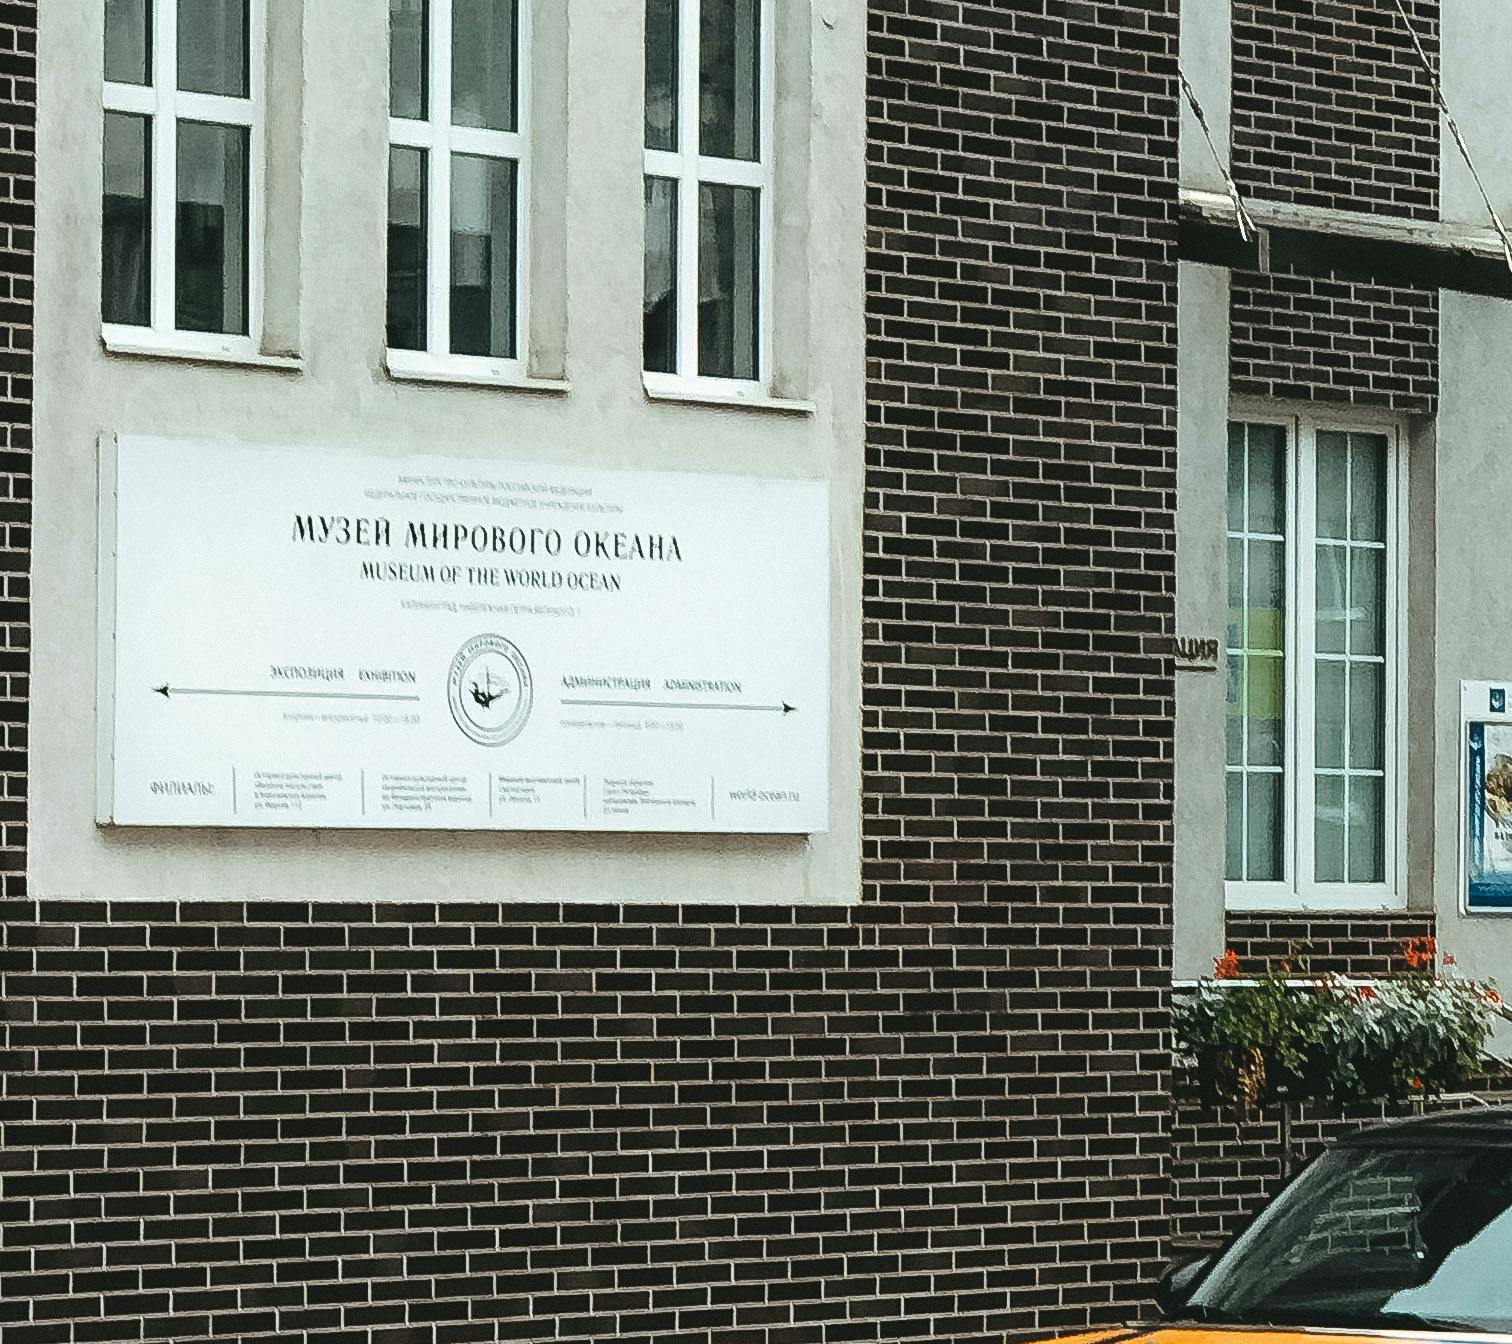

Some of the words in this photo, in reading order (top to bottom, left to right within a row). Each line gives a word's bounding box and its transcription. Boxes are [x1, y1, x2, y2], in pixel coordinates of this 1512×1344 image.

[291, 513, 391, 547] МУЗЕЙ
[404, 521, 561, 556] МИРОВОГО
[574, 530, 683, 561] ОКЕАНА
[360, 560, 435, 583] MUSEUM
[440, 564, 461, 584] OF
[466, 566, 500, 587] THE
[503, 568, 562, 589] WORLD
[567, 571, 621, 592] OCEAN
